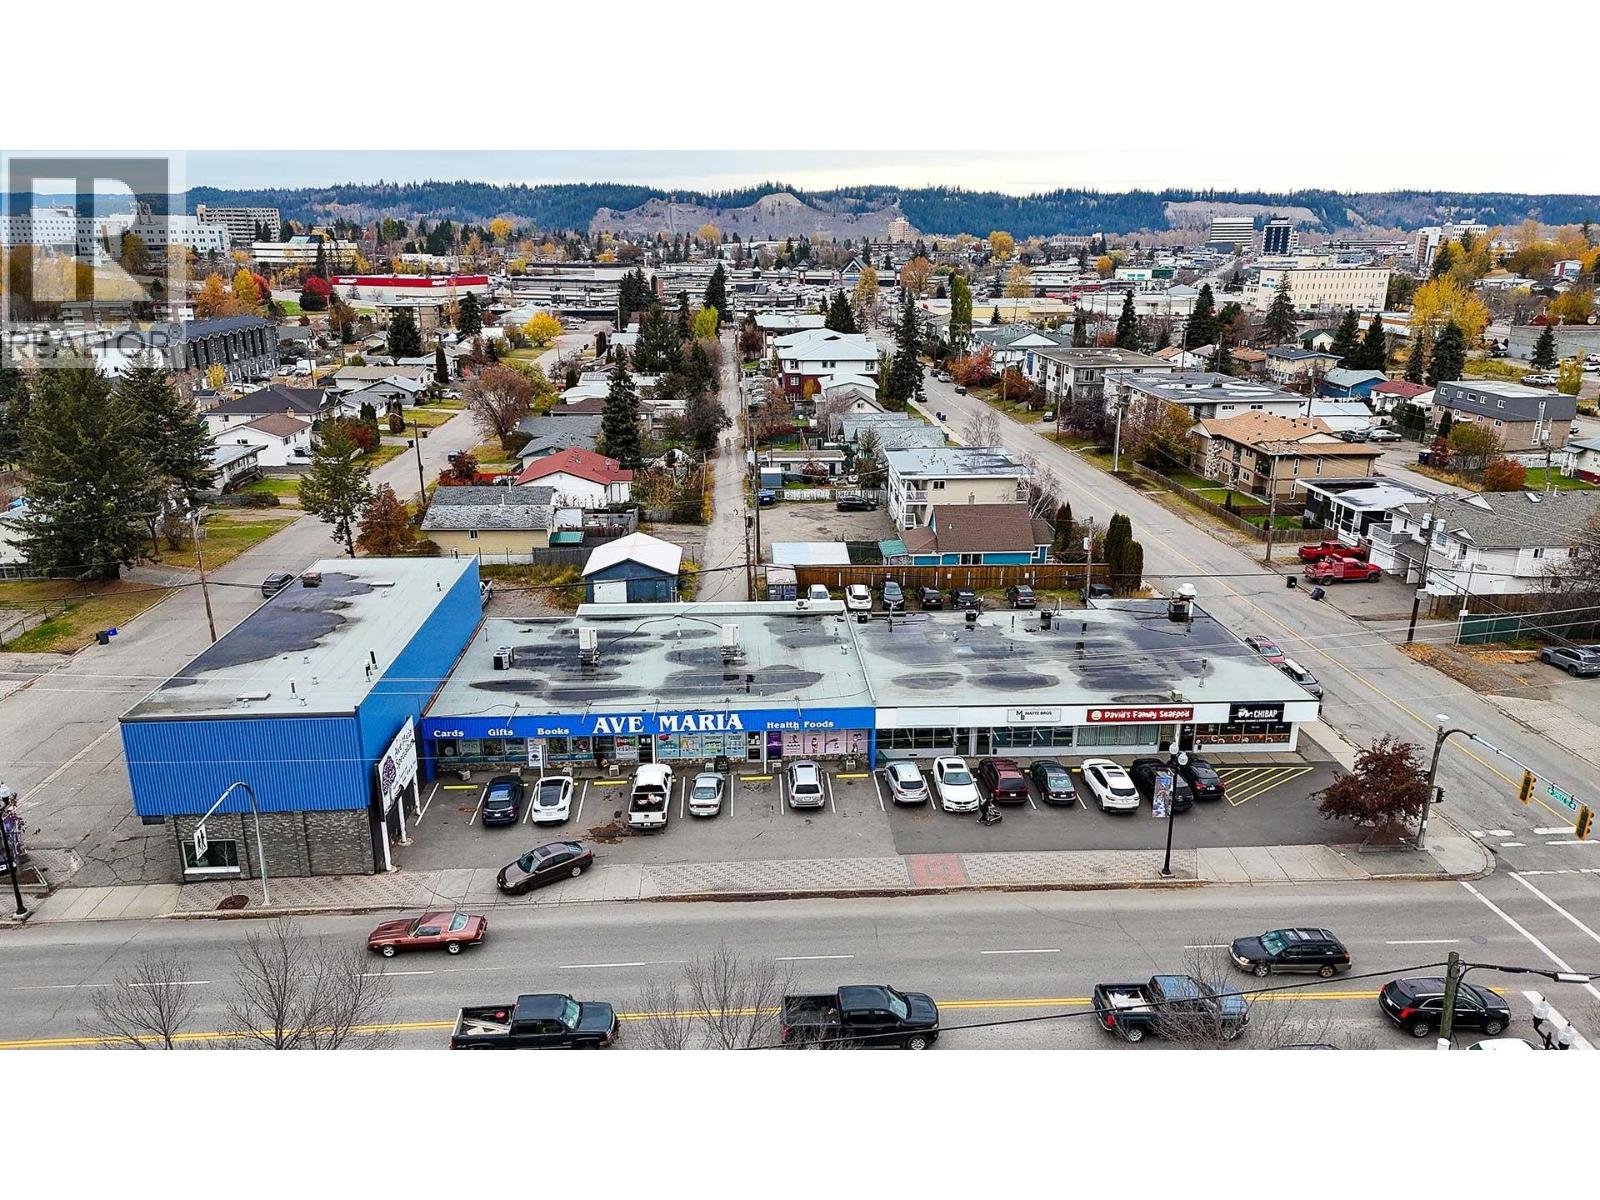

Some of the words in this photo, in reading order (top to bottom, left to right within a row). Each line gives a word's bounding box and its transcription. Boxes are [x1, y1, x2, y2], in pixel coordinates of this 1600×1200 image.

[1133, 711, 1157, 719] Family
[1159, 710, 1190, 719] Seafood
[1254, 709, 1278, 718] CHIBAP
[592, 716, 644, 734] AVE
[658, 713, 744, 732] MARIA
[767, 721, 799, 730] Health
[804, 720, 834, 729] Foods
[487, 728, 514, 736] Gifts
[537, 727, 570, 735] Books
